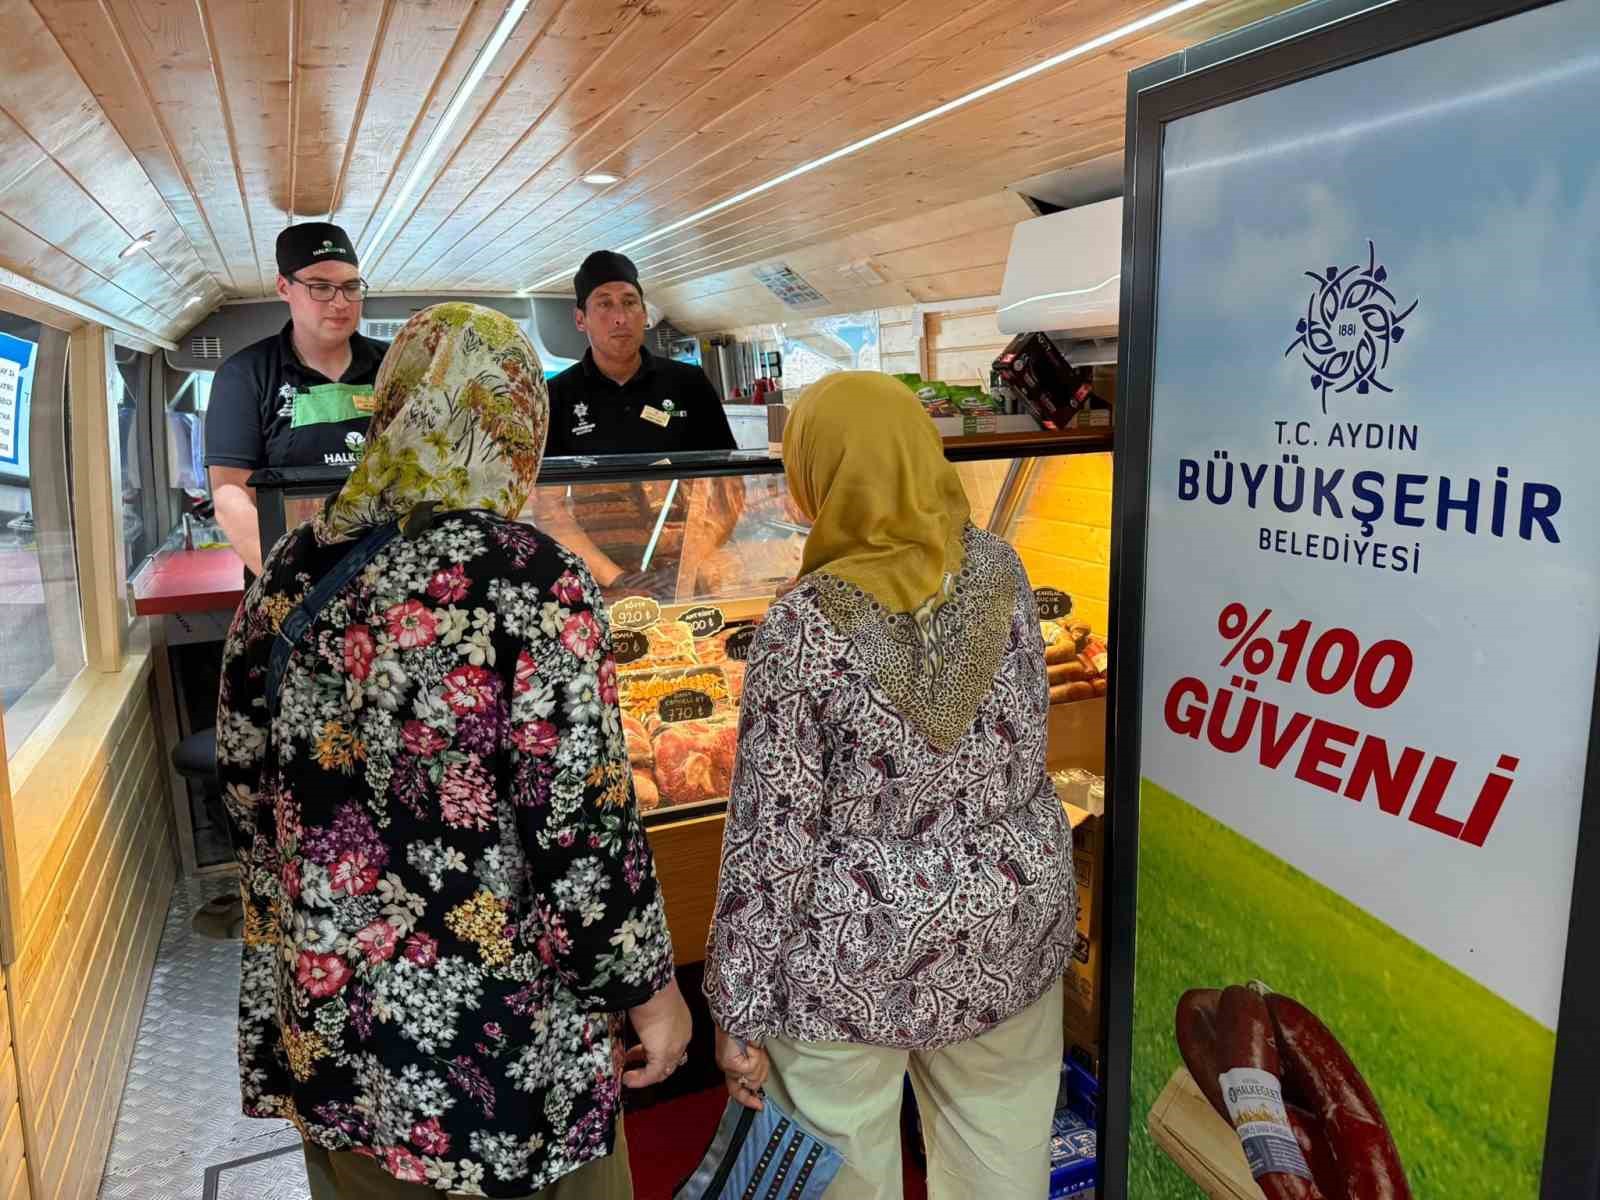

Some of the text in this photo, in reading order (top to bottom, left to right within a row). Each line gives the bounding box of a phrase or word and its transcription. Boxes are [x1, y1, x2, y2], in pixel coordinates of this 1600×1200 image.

[1338, 324, 1357, 337] 1881
[1274, 420, 1418, 451] T.C. AYDIN
[1177, 449, 1562, 544] BÜYÜKŞEHİR
[1258, 527, 1421, 575] BELEDİYESİ
[618, 610, 642, 624] 920
[1217, 602, 1414, 711] %100
[1163, 675, 1520, 848] GÜVENLİ
